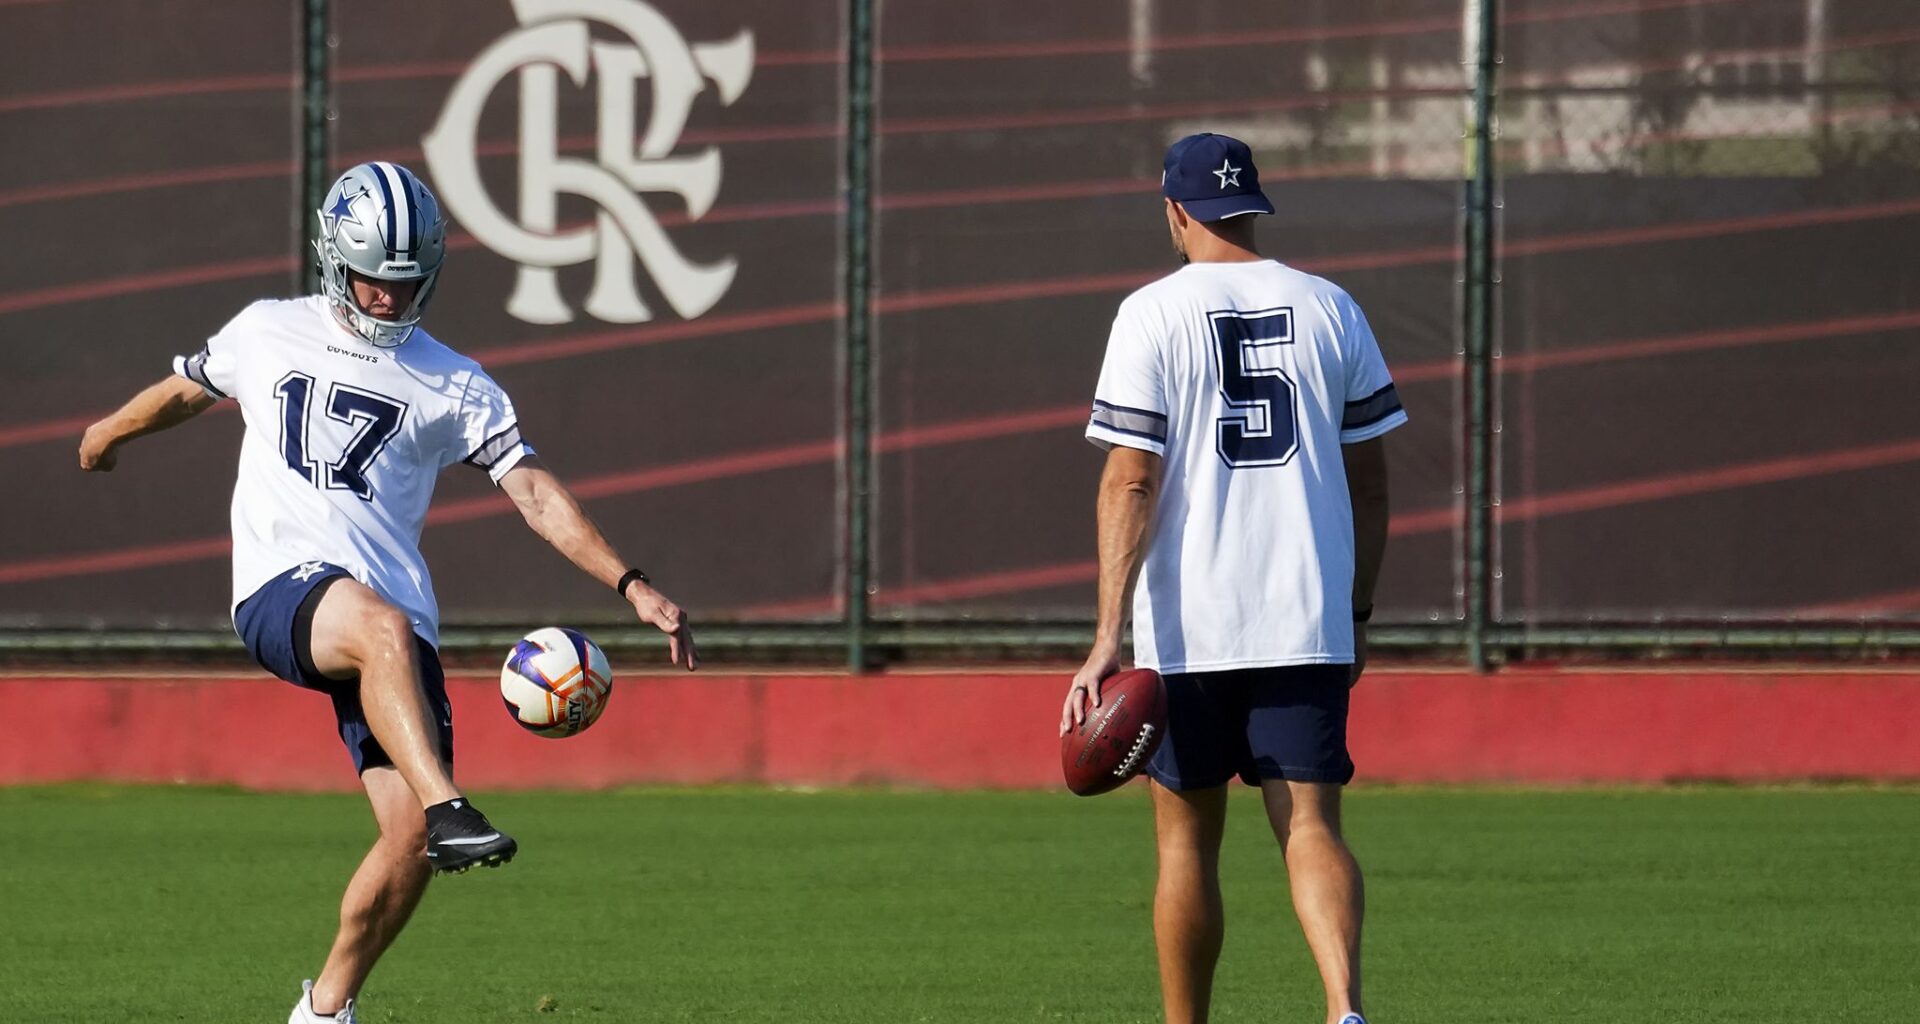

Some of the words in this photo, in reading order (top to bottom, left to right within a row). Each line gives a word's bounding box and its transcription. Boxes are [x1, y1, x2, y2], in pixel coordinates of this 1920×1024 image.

[326, 344, 379, 364] COWBOYS
[1206, 306, 1300, 470] 5
[273, 370, 409, 503] 17
